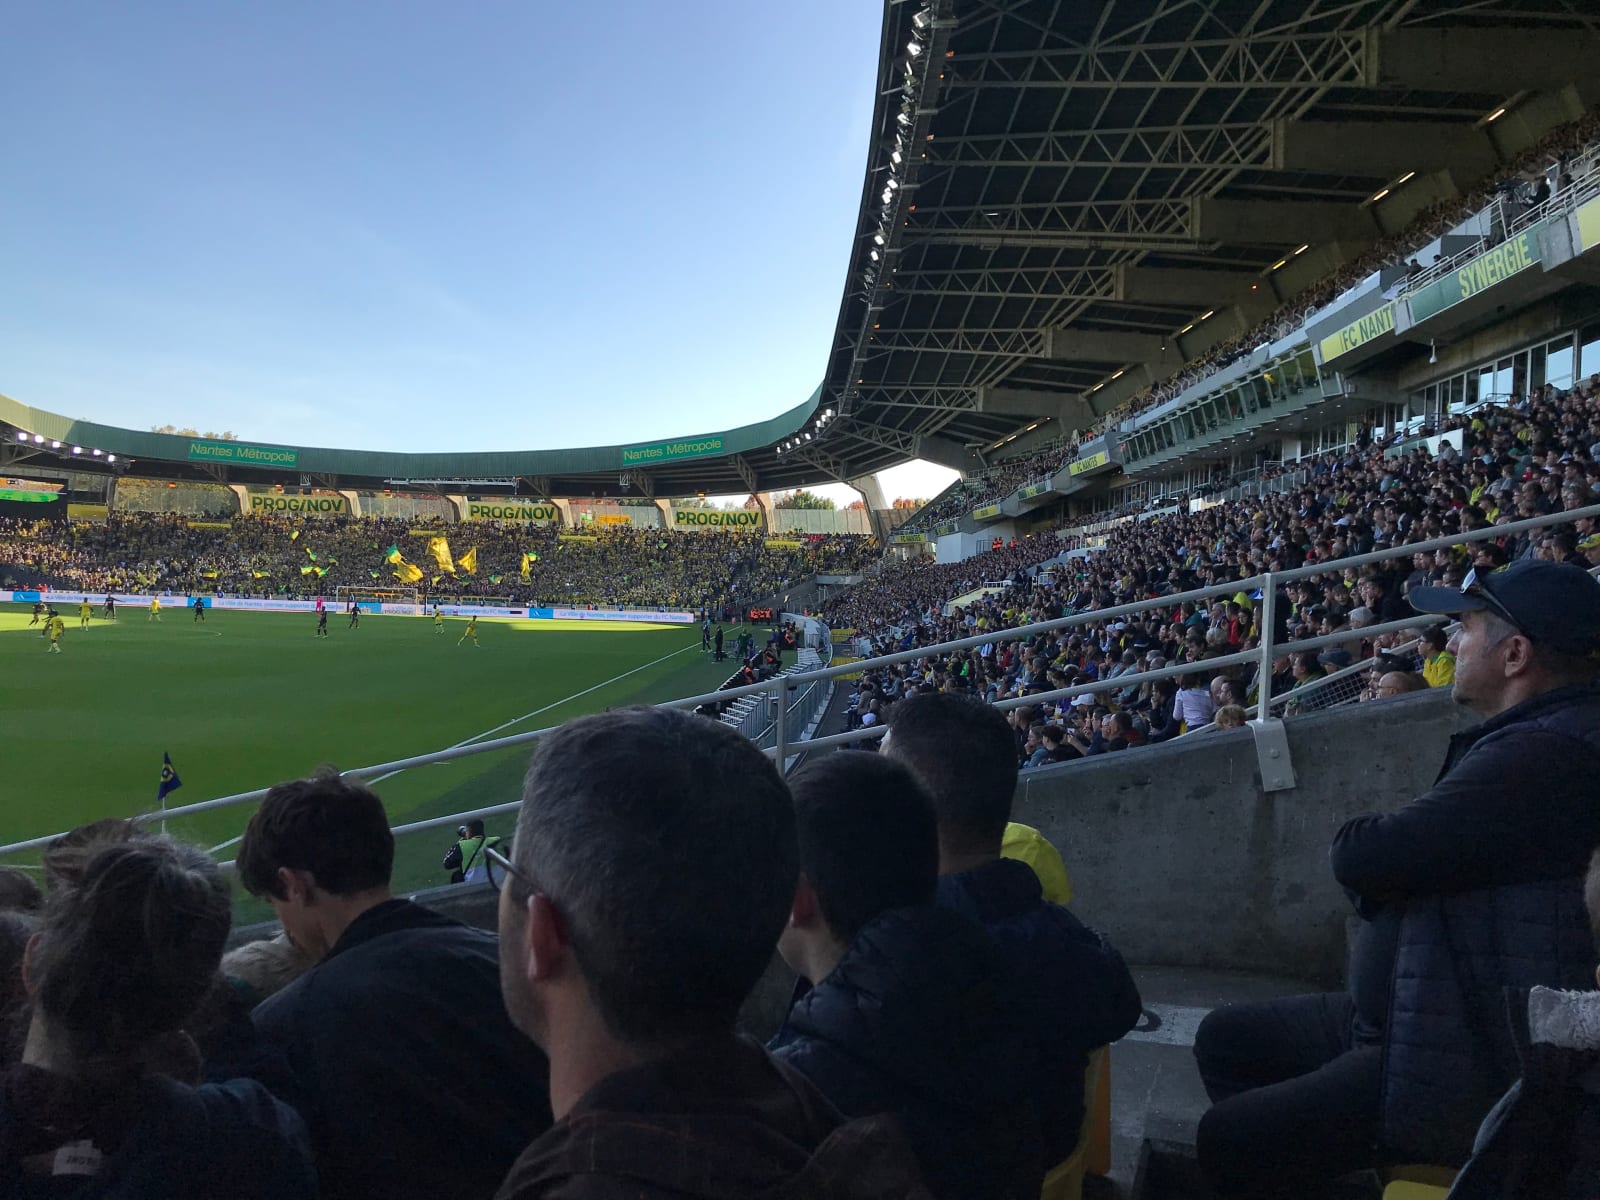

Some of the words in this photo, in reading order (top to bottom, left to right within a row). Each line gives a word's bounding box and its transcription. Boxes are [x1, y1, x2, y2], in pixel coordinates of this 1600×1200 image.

[1458, 233, 1532, 298] SYNERGIE
[1342, 326, 1358, 351] FC
[1358, 305, 1393, 342] NANT
[190, 443, 233, 457] Nantes
[237, 447, 296, 463] Métropole
[624, 447, 663, 460] Nantes
[666, 439, 722, 456] Métropole
